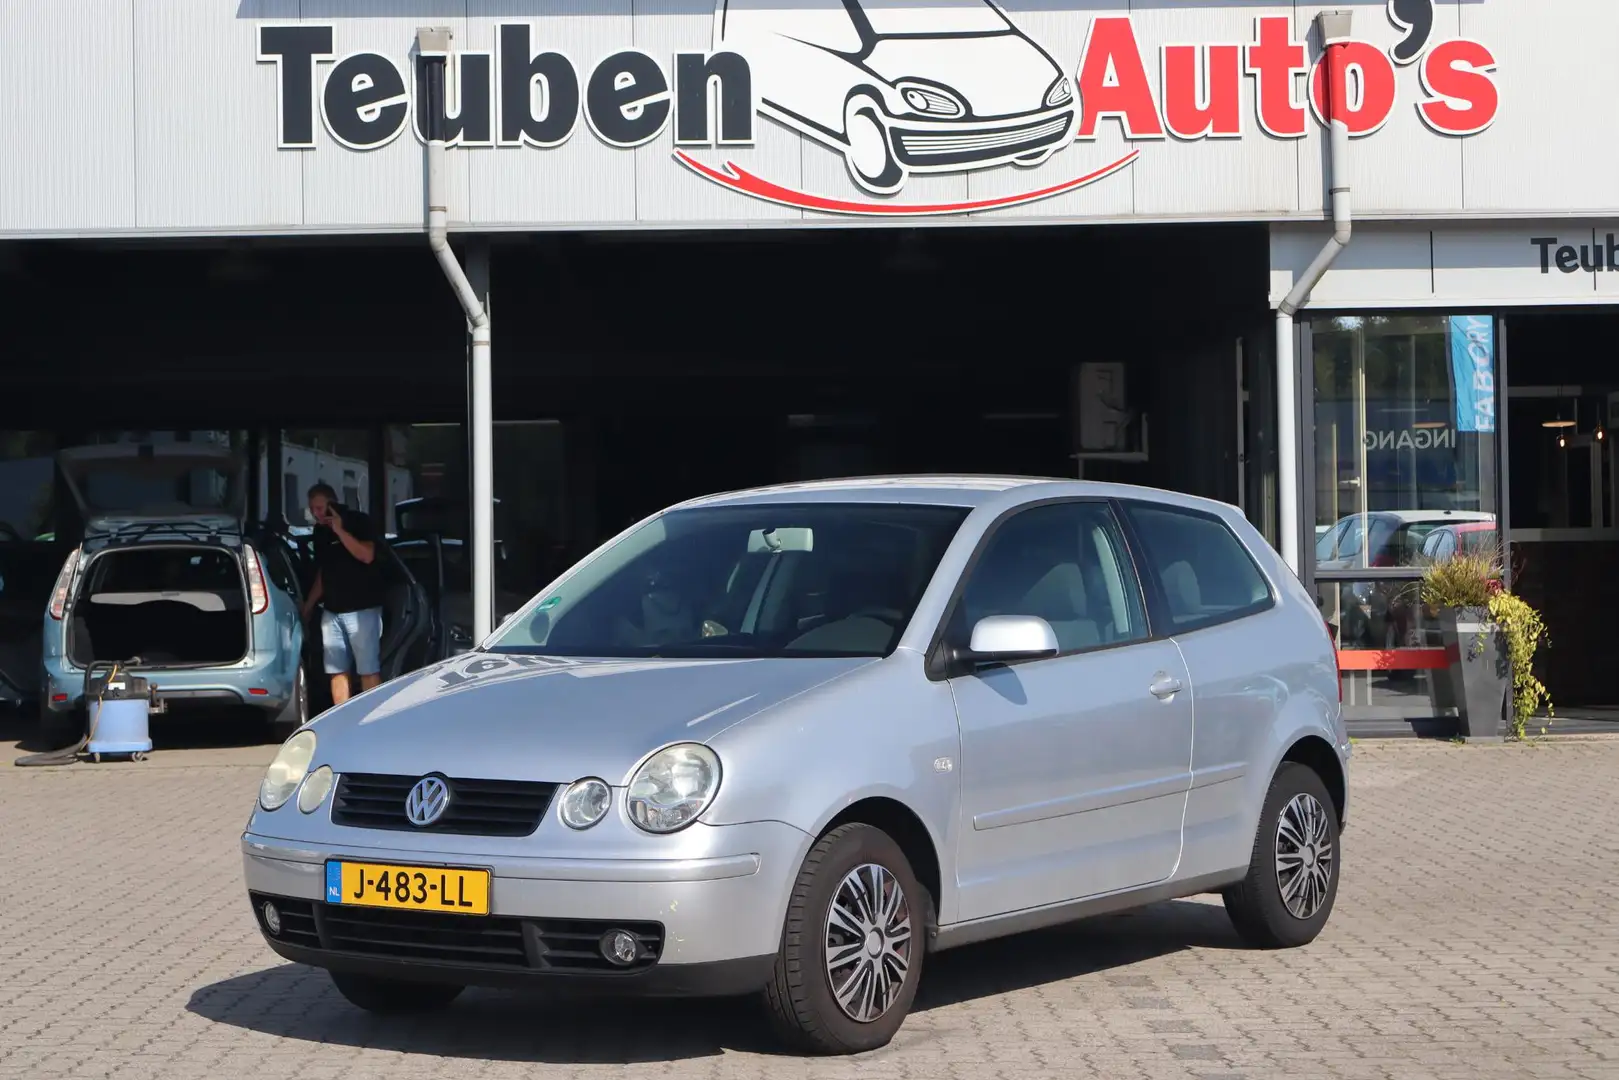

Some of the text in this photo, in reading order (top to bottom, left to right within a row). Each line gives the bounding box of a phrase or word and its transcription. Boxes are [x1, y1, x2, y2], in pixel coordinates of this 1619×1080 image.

[258, 0, 1498, 147] Teuben Auto's
[329, 886, 340, 896] NL
[354, 869, 473, 907] J-483-LL
